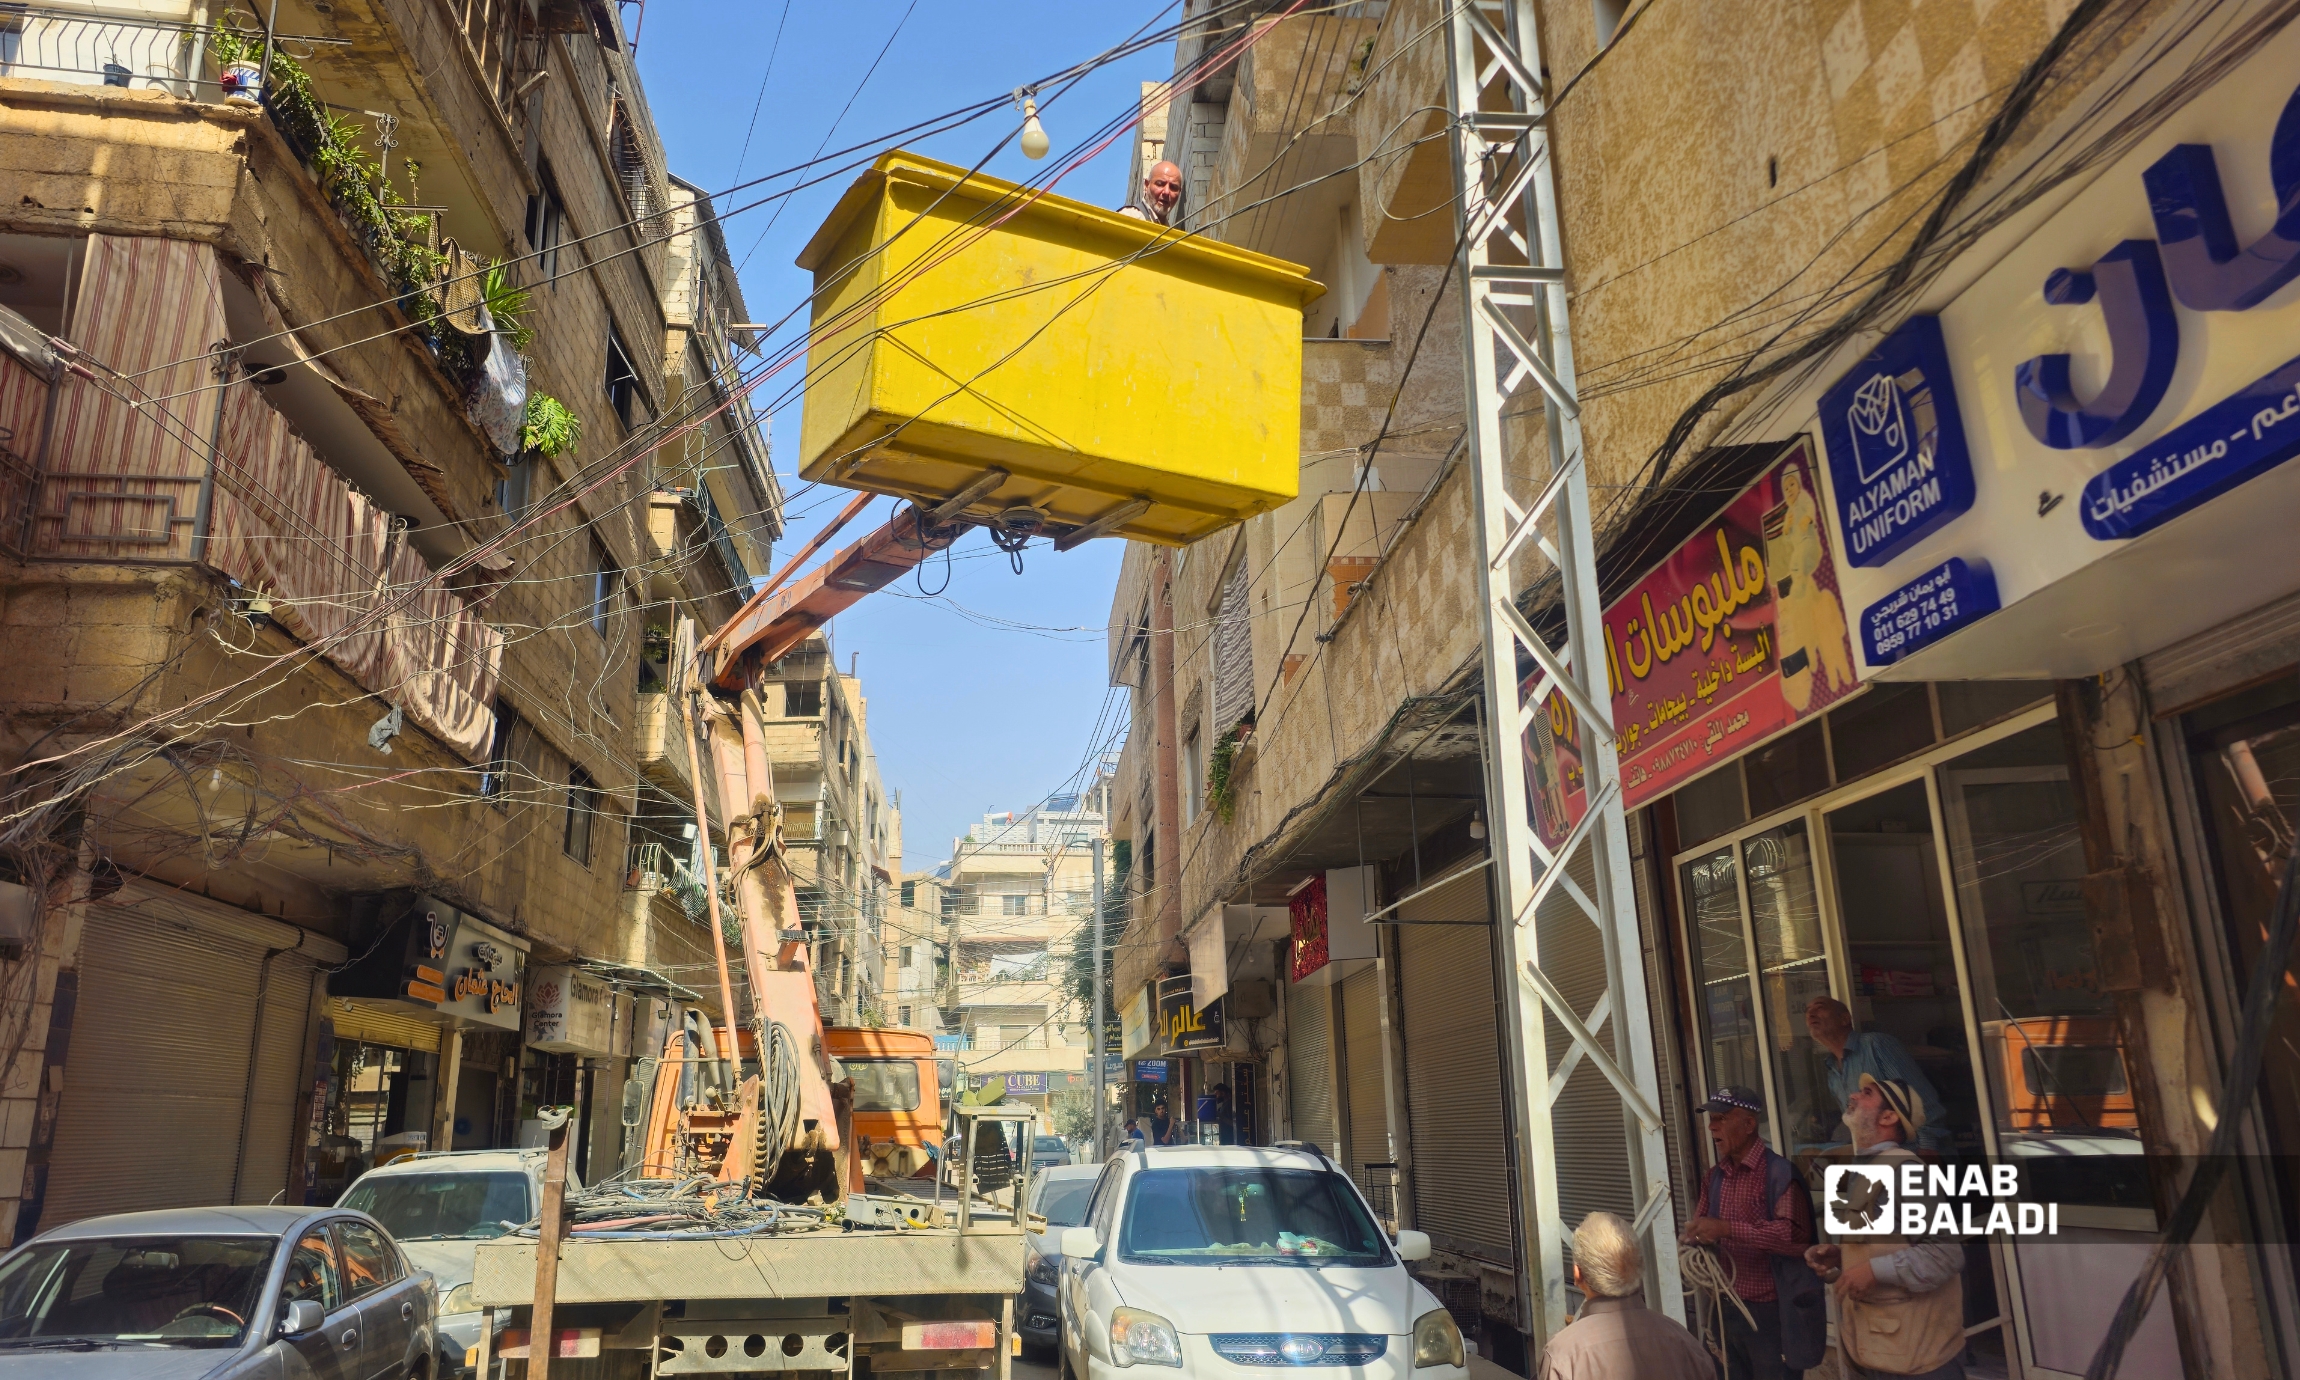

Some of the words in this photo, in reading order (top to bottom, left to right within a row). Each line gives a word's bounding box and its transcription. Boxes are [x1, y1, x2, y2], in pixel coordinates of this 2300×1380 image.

[1850, 448, 1934, 528] ALYAMAN
[2091, 440, 2228, 521] مستشفيات
[1852, 477, 1941, 554] UNIFORM
[1909, 580, 1935, 602] يمان
[1935, 563, 1951, 587] أبو
[1625, 527, 1766, 679] ملبوسات
[1874, 621, 1894, 641] 011
[1896, 608, 1918, 629] 629
[1920, 598, 1937, 615] 74
[1939, 588, 1956, 605] 49
[1876, 631, 1905, 655] 0959
[1906, 621, 1921, 640] 77
[1924, 612, 1940, 629] 10
[1942, 602, 1959, 620] 31
[1730, 621, 1771, 675] ألبسة
[1691, 659, 1734, 706] داخلية
[1727, 709, 1750, 735] محمد
[455, 966, 488, 1003] عثمان
[490, 978, 519, 1015] الحاج
[570, 973, 599, 1006] Glamora
[532, 1011, 563, 1019] Glamora
[1007, 1074, 1041, 1087] CUBE
[1147, 1060, 1167, 1068] ZOOM
